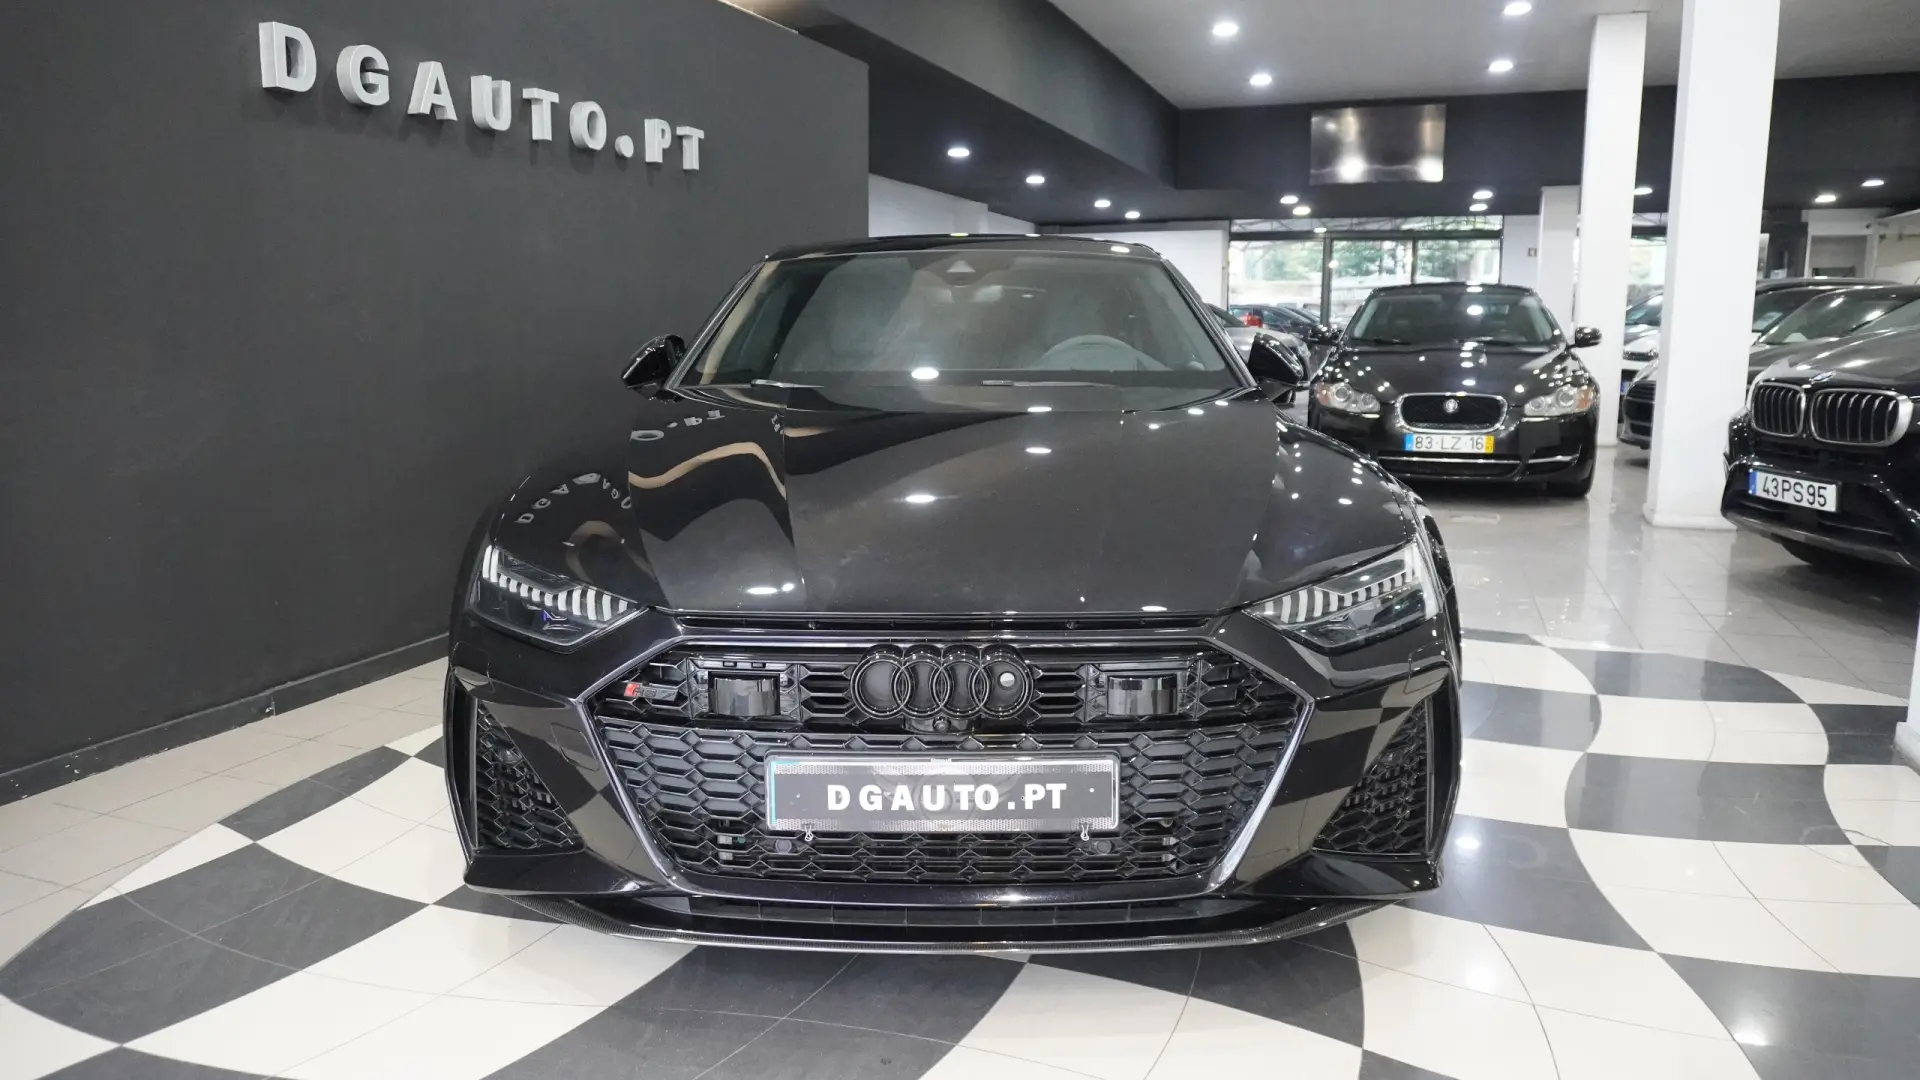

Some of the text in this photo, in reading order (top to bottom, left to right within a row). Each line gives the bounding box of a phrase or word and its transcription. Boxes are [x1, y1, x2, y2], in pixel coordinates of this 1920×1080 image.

[258, 21, 705, 170] DGAUTO.PT
[1762, 475, 1827, 507] 43PS95
[827, 783, 1067, 811] DGAUTO.PT
